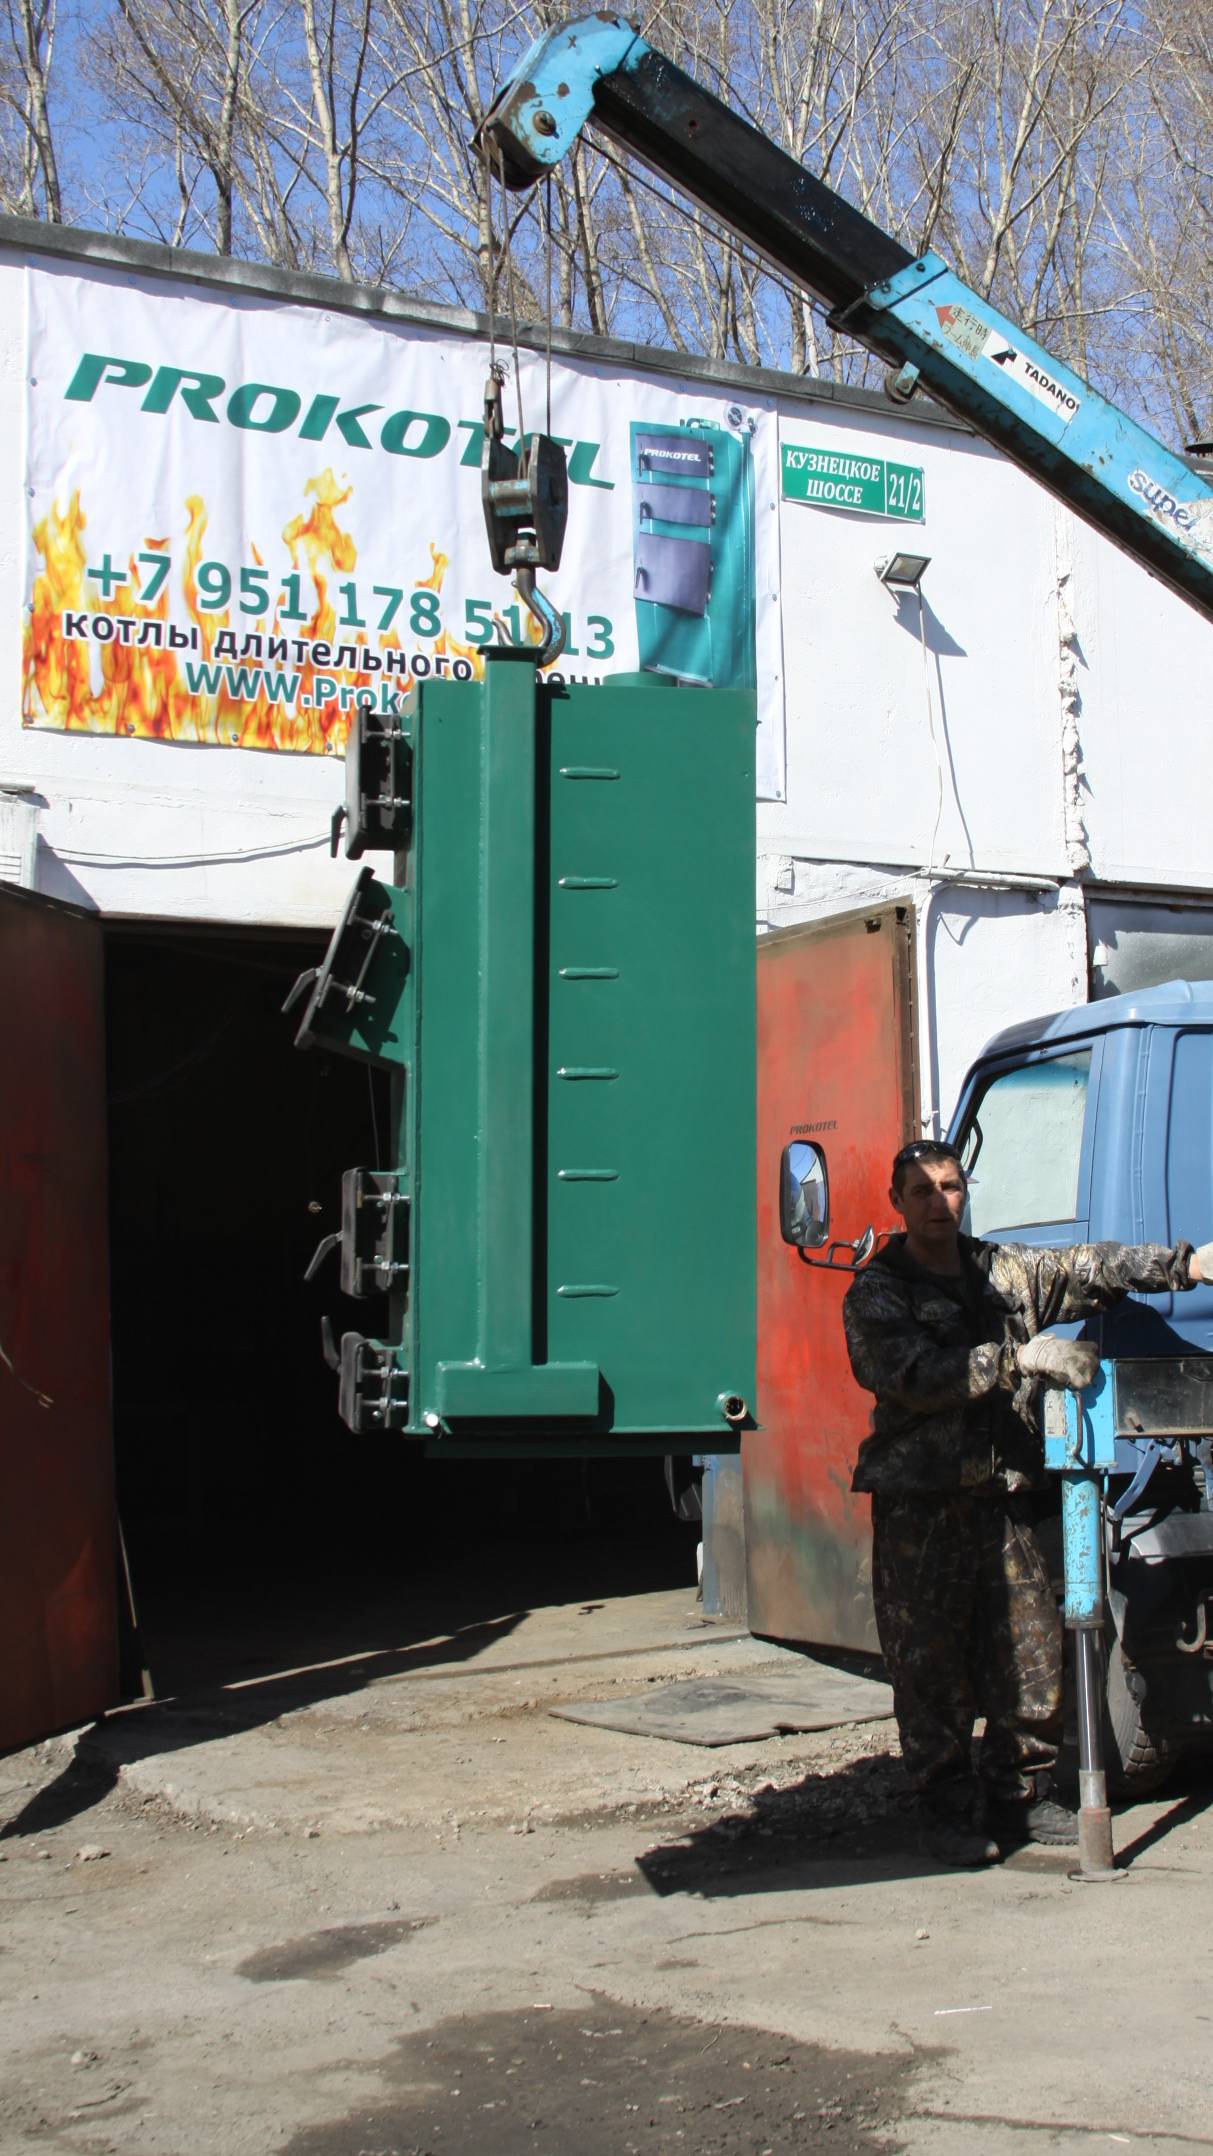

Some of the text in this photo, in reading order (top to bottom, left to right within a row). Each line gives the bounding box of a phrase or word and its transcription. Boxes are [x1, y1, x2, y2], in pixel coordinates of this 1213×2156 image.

[1024, 362, 1076, 410] TADANO
[643, 448, 701, 462] PROKOTEL
[785, 450, 880, 482] КУЗНЕЦКОЕ
[806, 479, 863, 504] ШОССЕ
[889, 472, 921, 514] 21/2
[87, 553, 171, 601] +7
[197, 562, 307, 622] 951
[339, 582, 442, 638] 178
[464, 599, 525, 646] 51
[65, 612, 472, 681] котлы длительного
